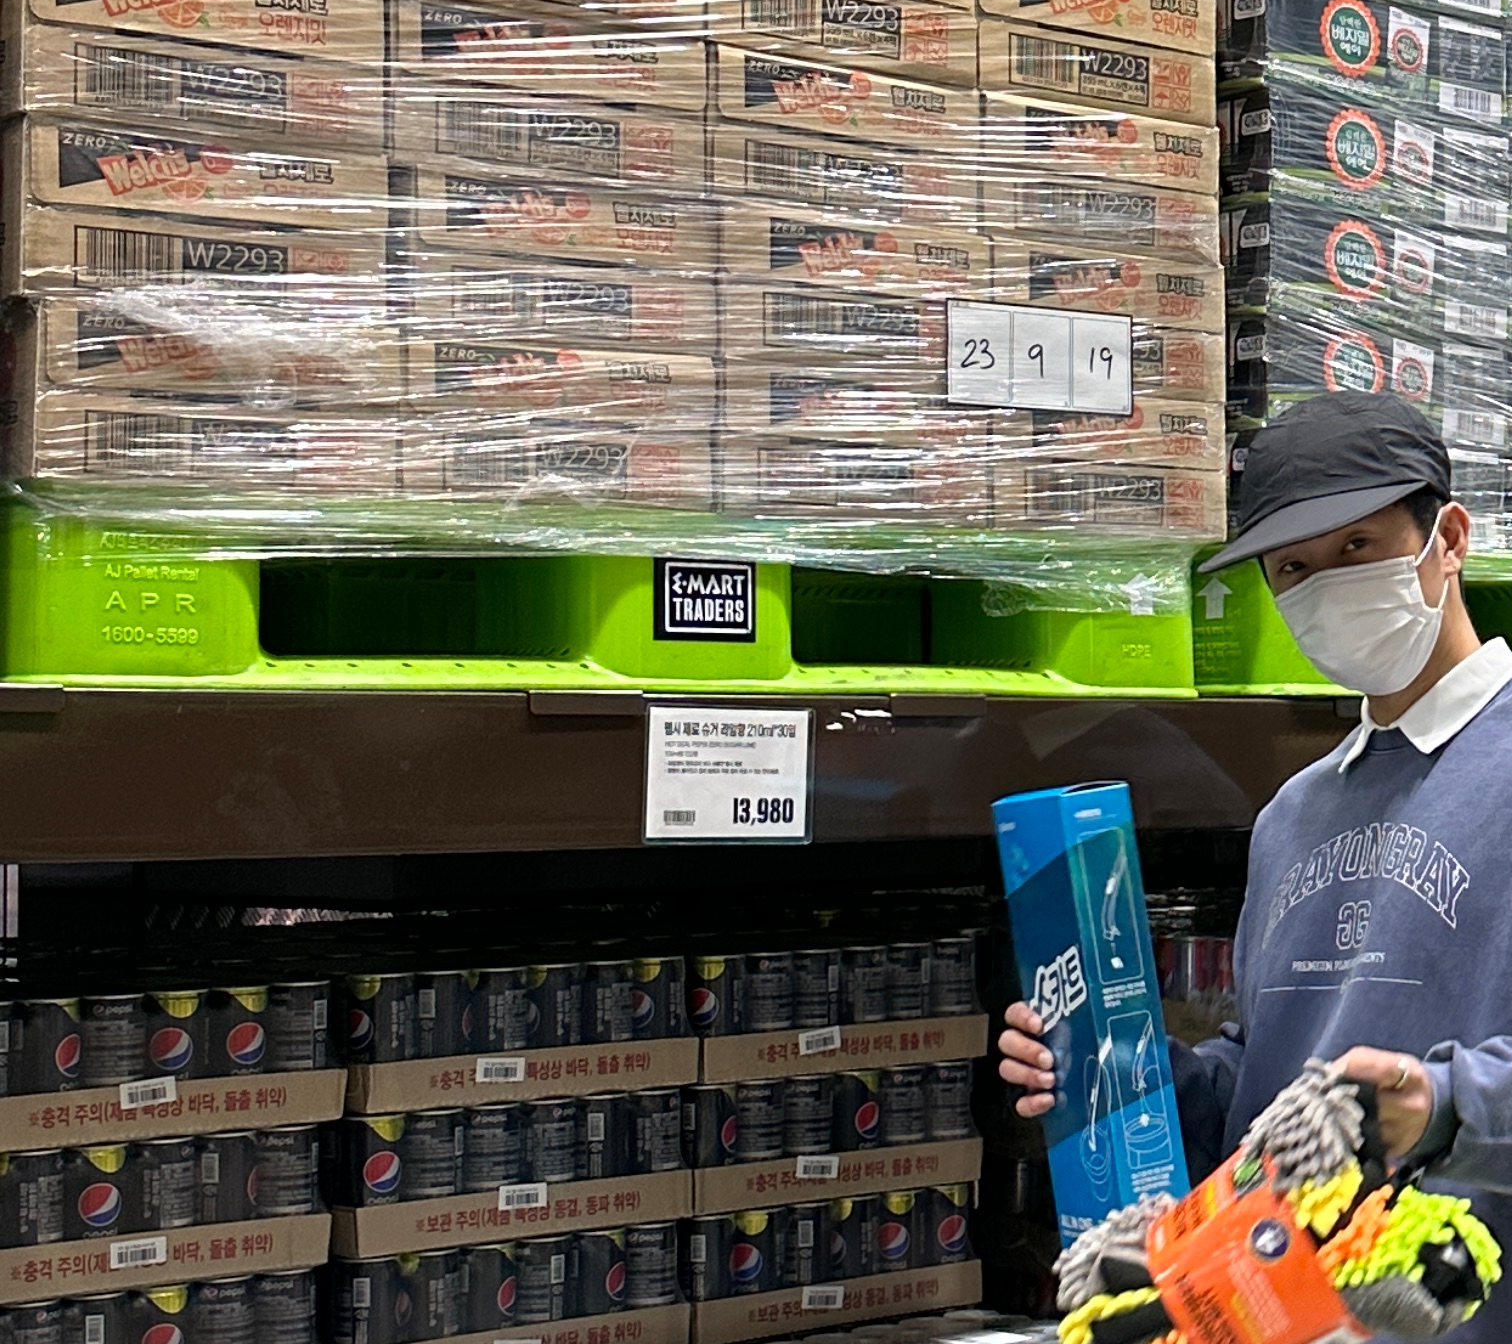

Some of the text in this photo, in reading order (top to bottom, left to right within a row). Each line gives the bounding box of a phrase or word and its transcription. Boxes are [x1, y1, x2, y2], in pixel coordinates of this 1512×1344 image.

[1081, 47, 1148, 81] W2293
[959, 338, 1114, 380] 23 9 19
[104, 563, 122, 579] AJ
[672, 597, 745, 623] TRADERS
[101, 625, 199, 645] 1600-5599
[732, 796, 795, 826] 13,980
[223, 1089, 252, 1111] 돌출
[255, 1085, 288, 1108] 취약)
[586, 1193, 611, 1216] 동파
[614, 1190, 642, 1212] 취약)
